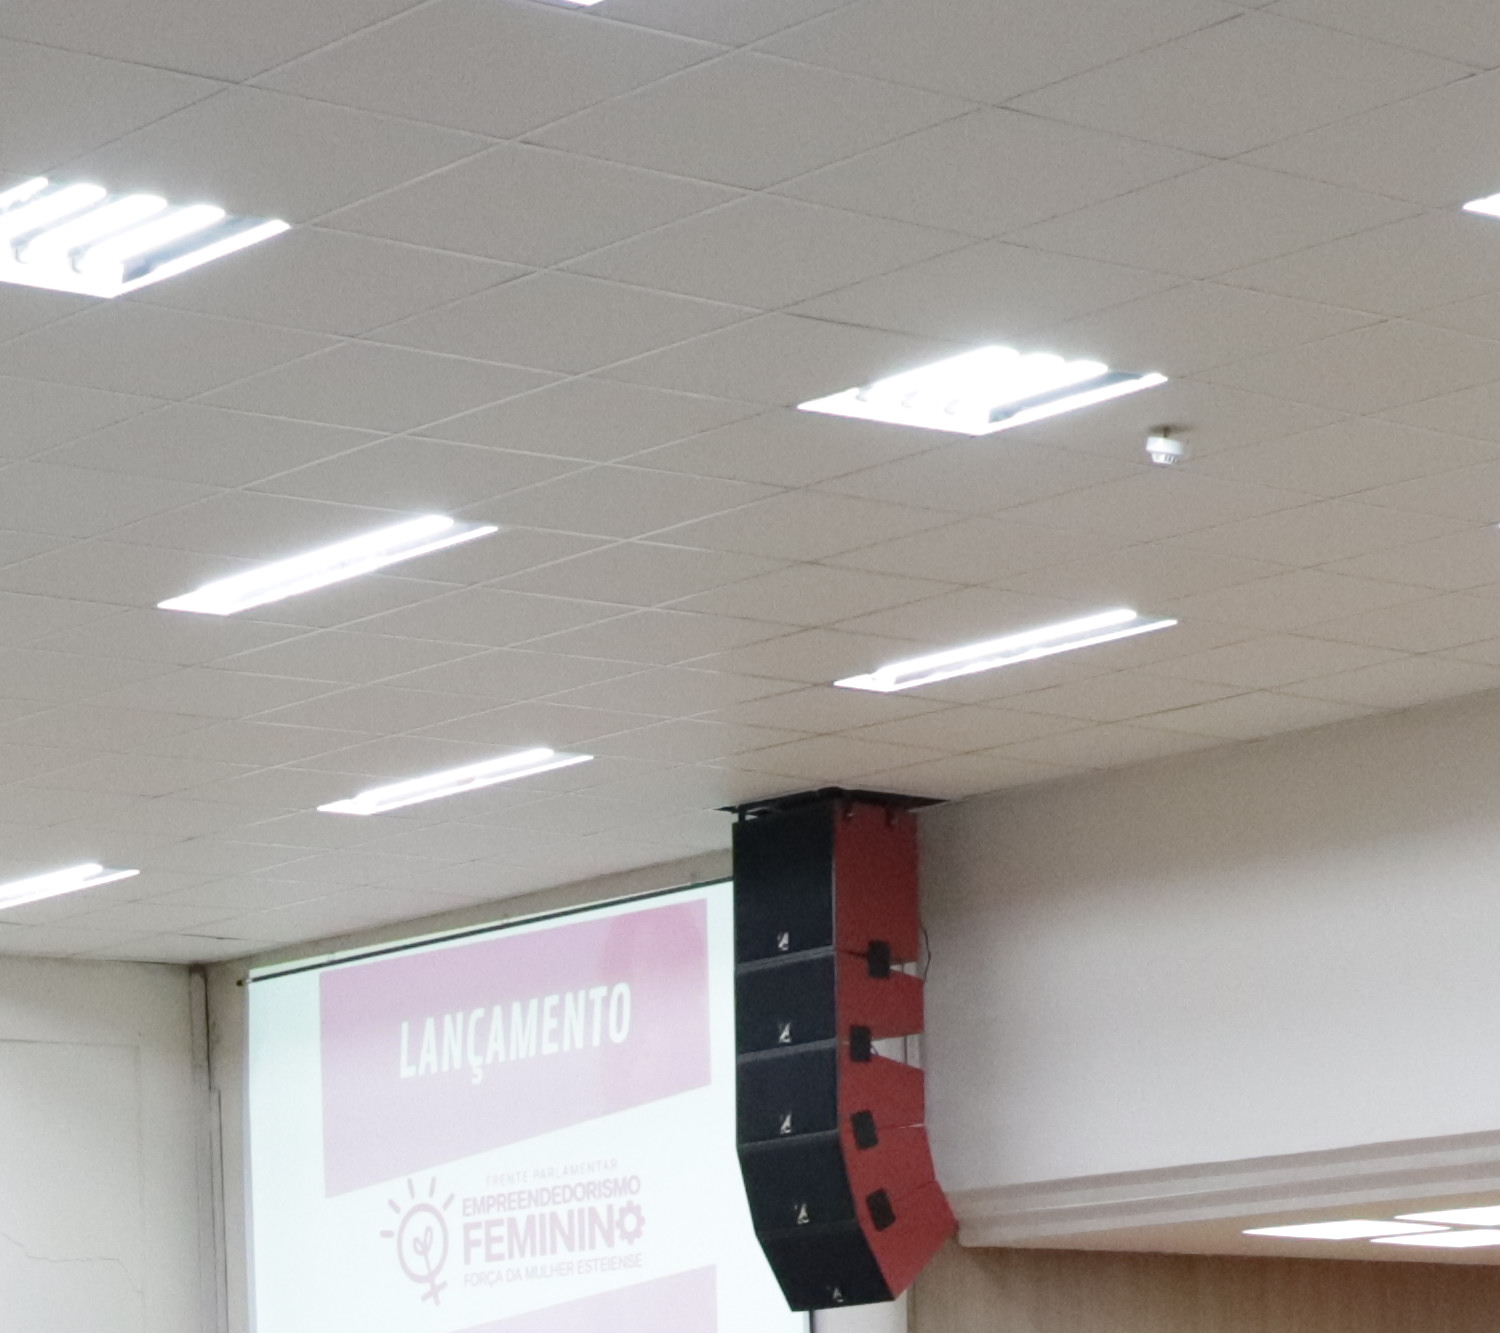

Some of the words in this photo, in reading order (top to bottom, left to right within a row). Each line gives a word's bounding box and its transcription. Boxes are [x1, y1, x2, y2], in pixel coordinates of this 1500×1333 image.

[399, 982, 632, 1086] LANÇAMENTO
[486, 1170, 528, 1186] FRENTE
[533, 1157, 619, 1180] PARLAMENTAR
[462, 1174, 642, 1218] EMPREENDEDORISMO
[462, 1199, 646, 1266] FEMININO
[463, 1270, 503, 1288] FORÇA
[505, 1268, 522, 1283] DA
[524, 1261, 575, 1280] MULHER
[577, 1252, 643, 1275] ESTEIENSE
